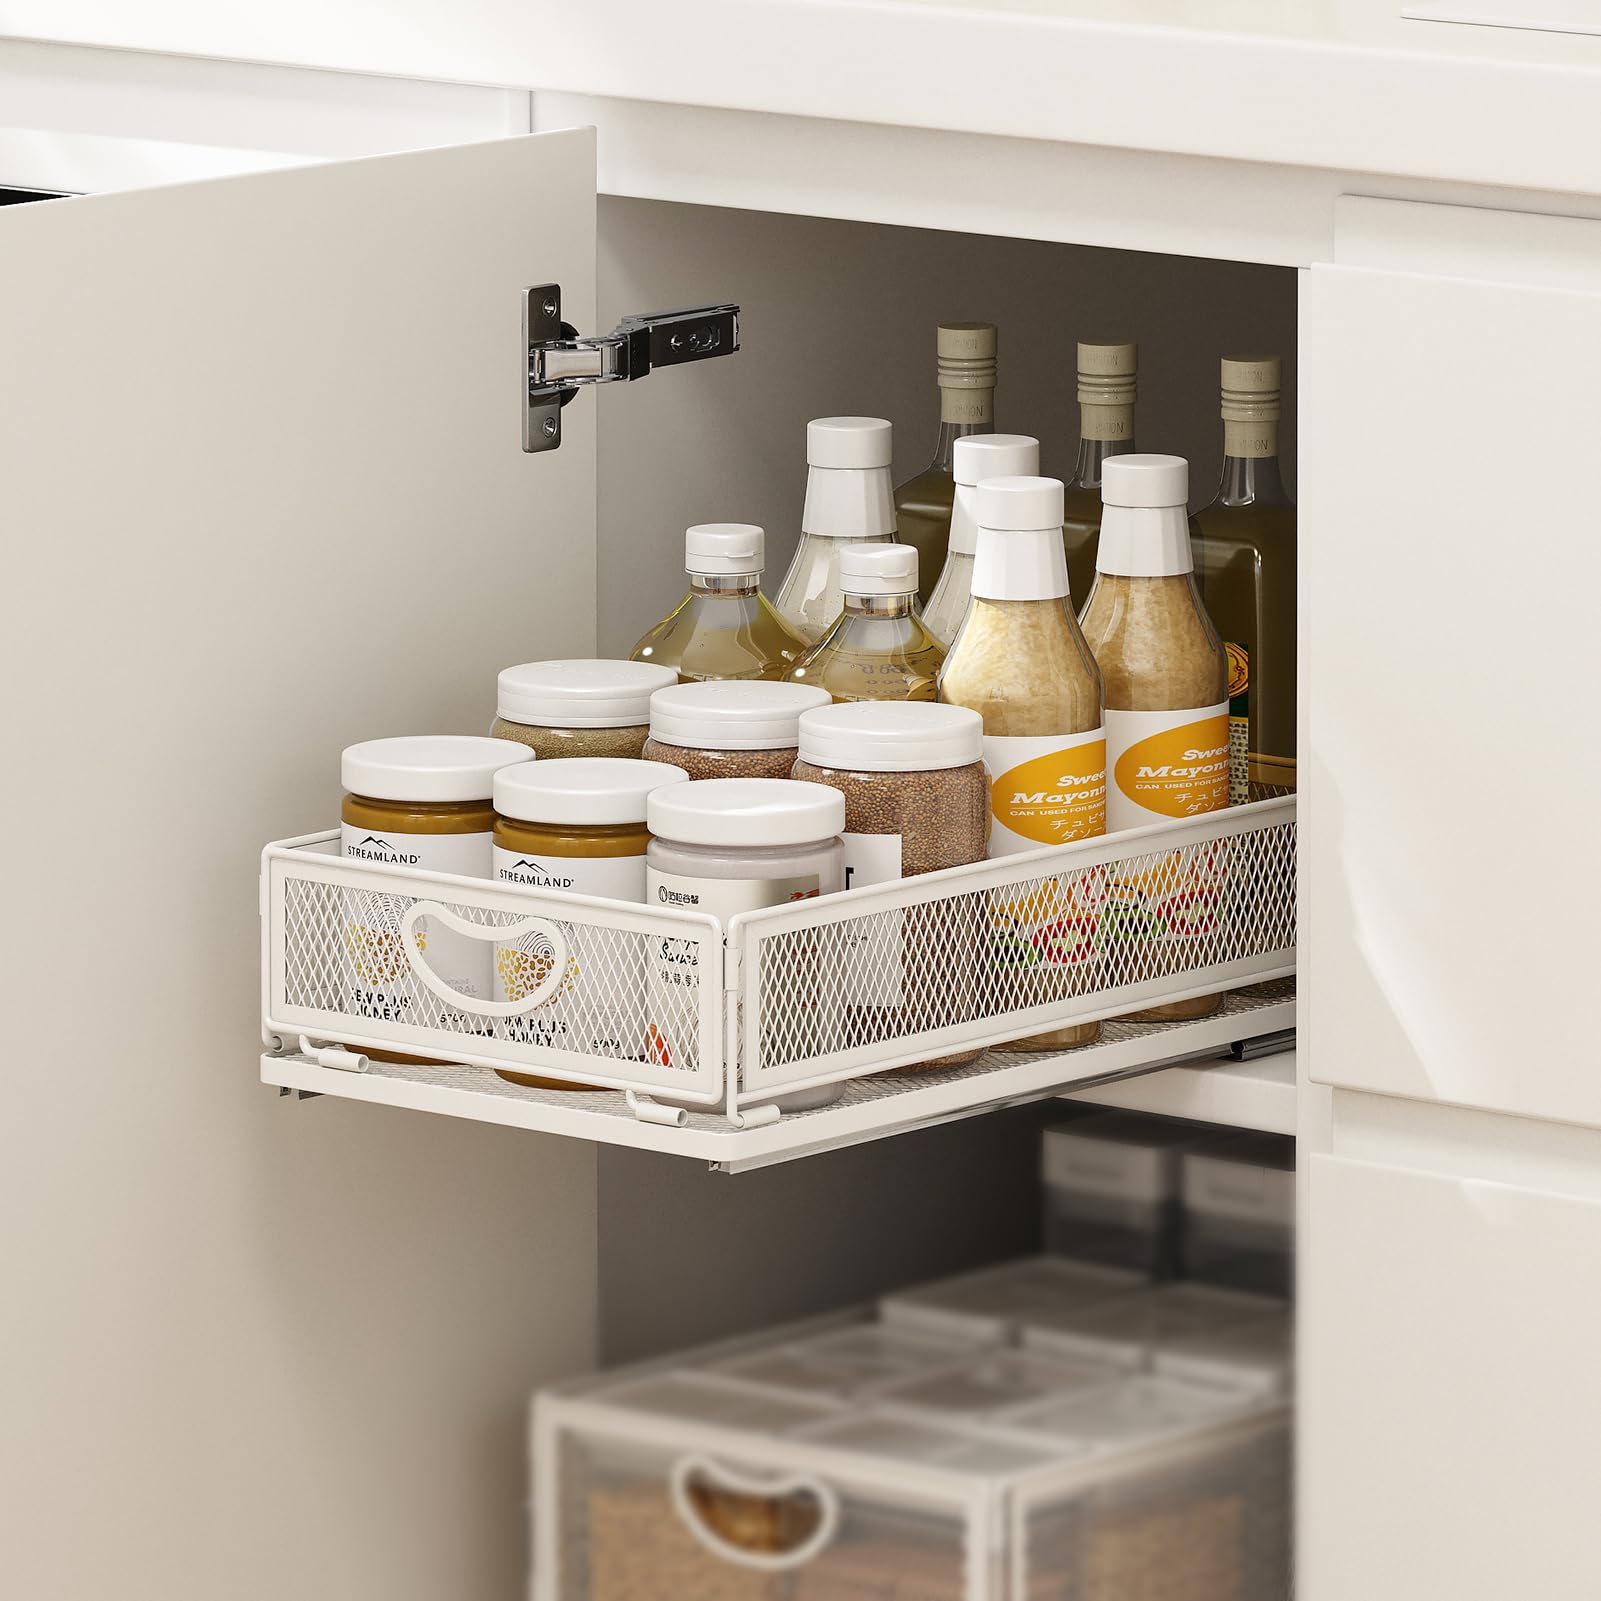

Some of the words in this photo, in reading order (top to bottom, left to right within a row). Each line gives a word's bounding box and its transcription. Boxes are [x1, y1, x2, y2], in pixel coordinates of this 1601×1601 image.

[1194, 779, 1212, 787] FOR
[1039, 808, 1068, 816] USED
[347, 845, 419, 864] STREAMLAND
[499, 868, 572, 888] STREAMLAND
